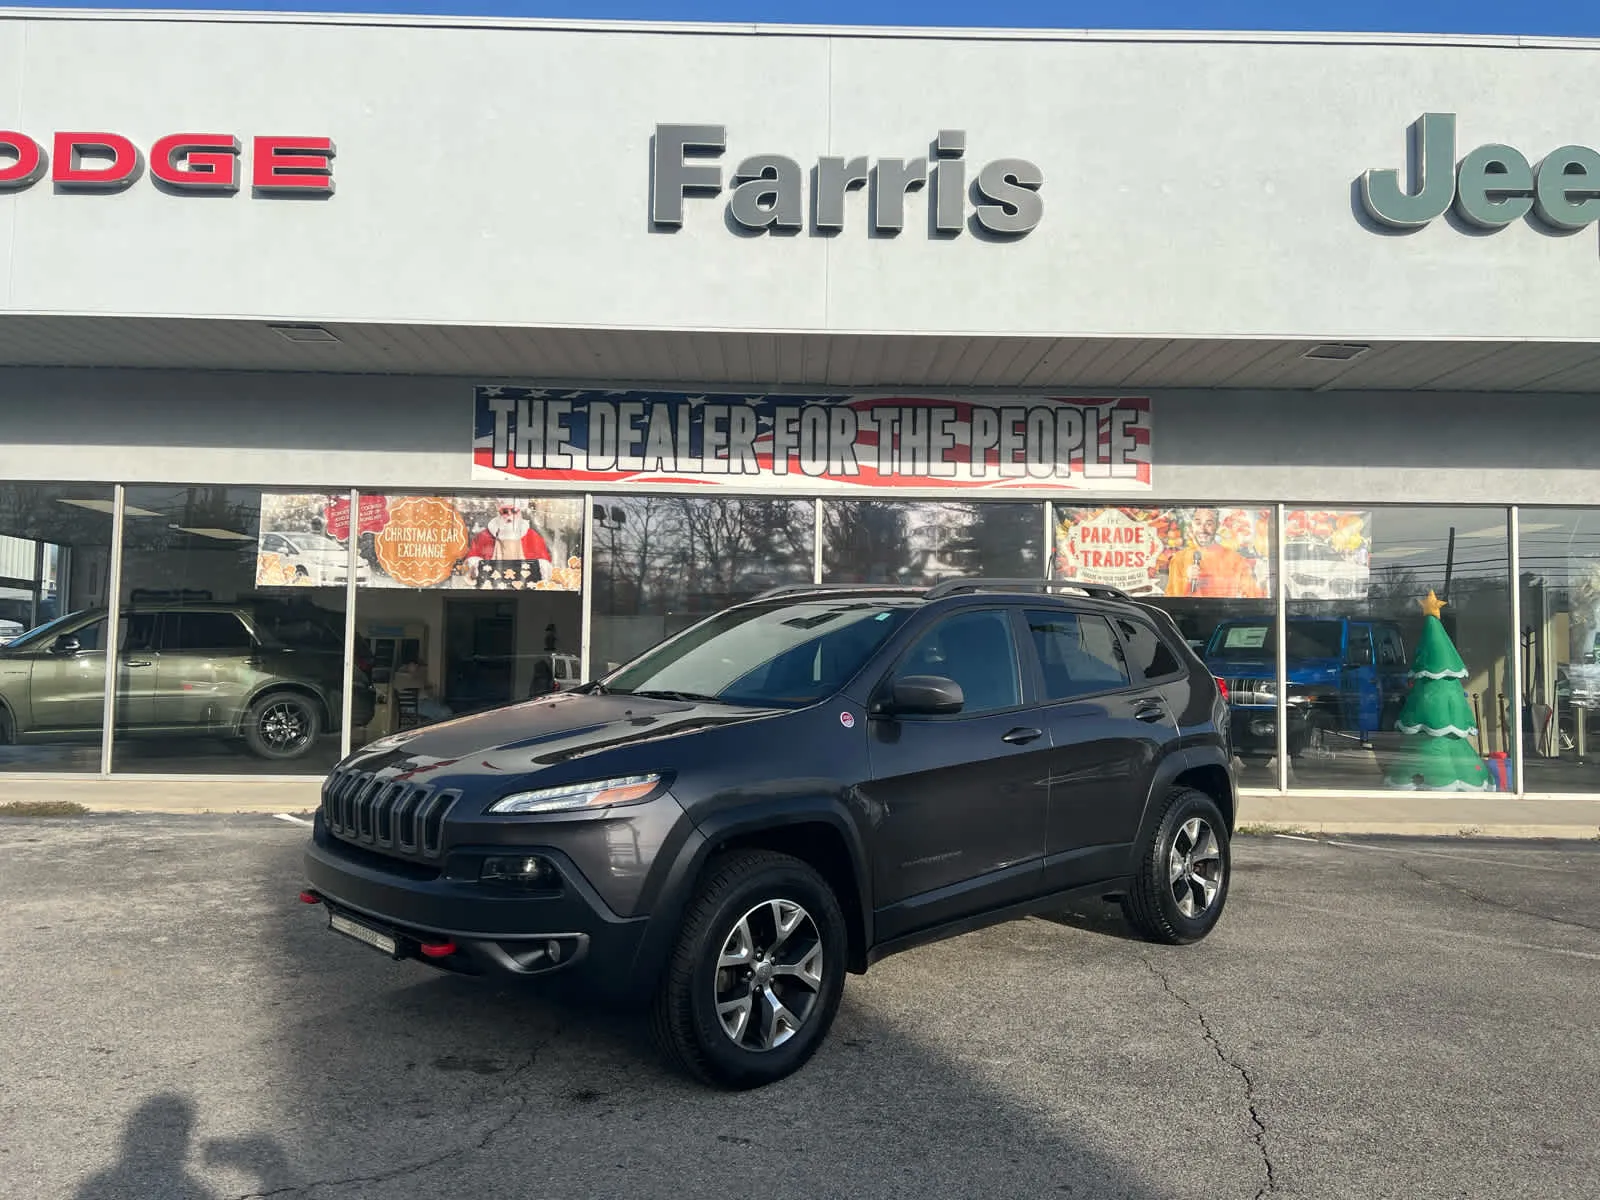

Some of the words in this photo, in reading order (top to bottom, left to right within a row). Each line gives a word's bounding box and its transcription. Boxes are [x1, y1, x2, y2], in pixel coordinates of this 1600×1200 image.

[652, 123, 1044, 236] Farris
[488, 399, 573, 469] THE
[586, 402, 760, 474] DEALER
[772, 404, 860, 476] FOR
[871, 406, 956, 477] THE
[970, 406, 1138, 478] PEOPLE
[385, 527, 438, 542] CHRISTMAS
[441, 528, 459, 542] CAR
[1081, 527, 1145, 543] PARADE
[398, 544, 446, 558] EXCHANGE
[1080, 550, 1146, 567] TRADES
